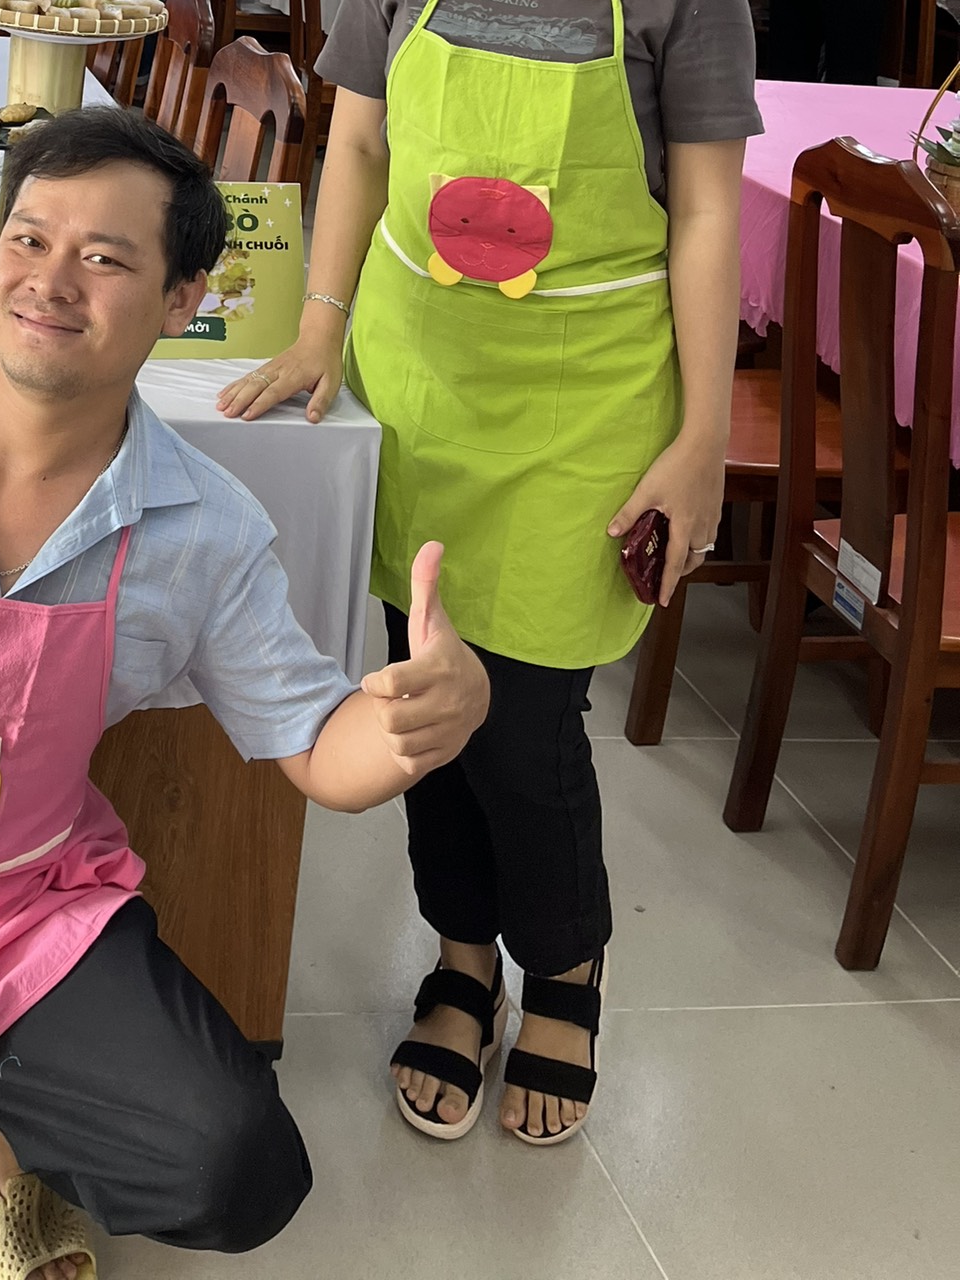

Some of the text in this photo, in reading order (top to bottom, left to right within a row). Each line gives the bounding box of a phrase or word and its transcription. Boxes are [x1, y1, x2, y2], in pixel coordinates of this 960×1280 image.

[225, 193, 268, 204] Chánh
[224, 235, 289, 250] NH CHUỐI
